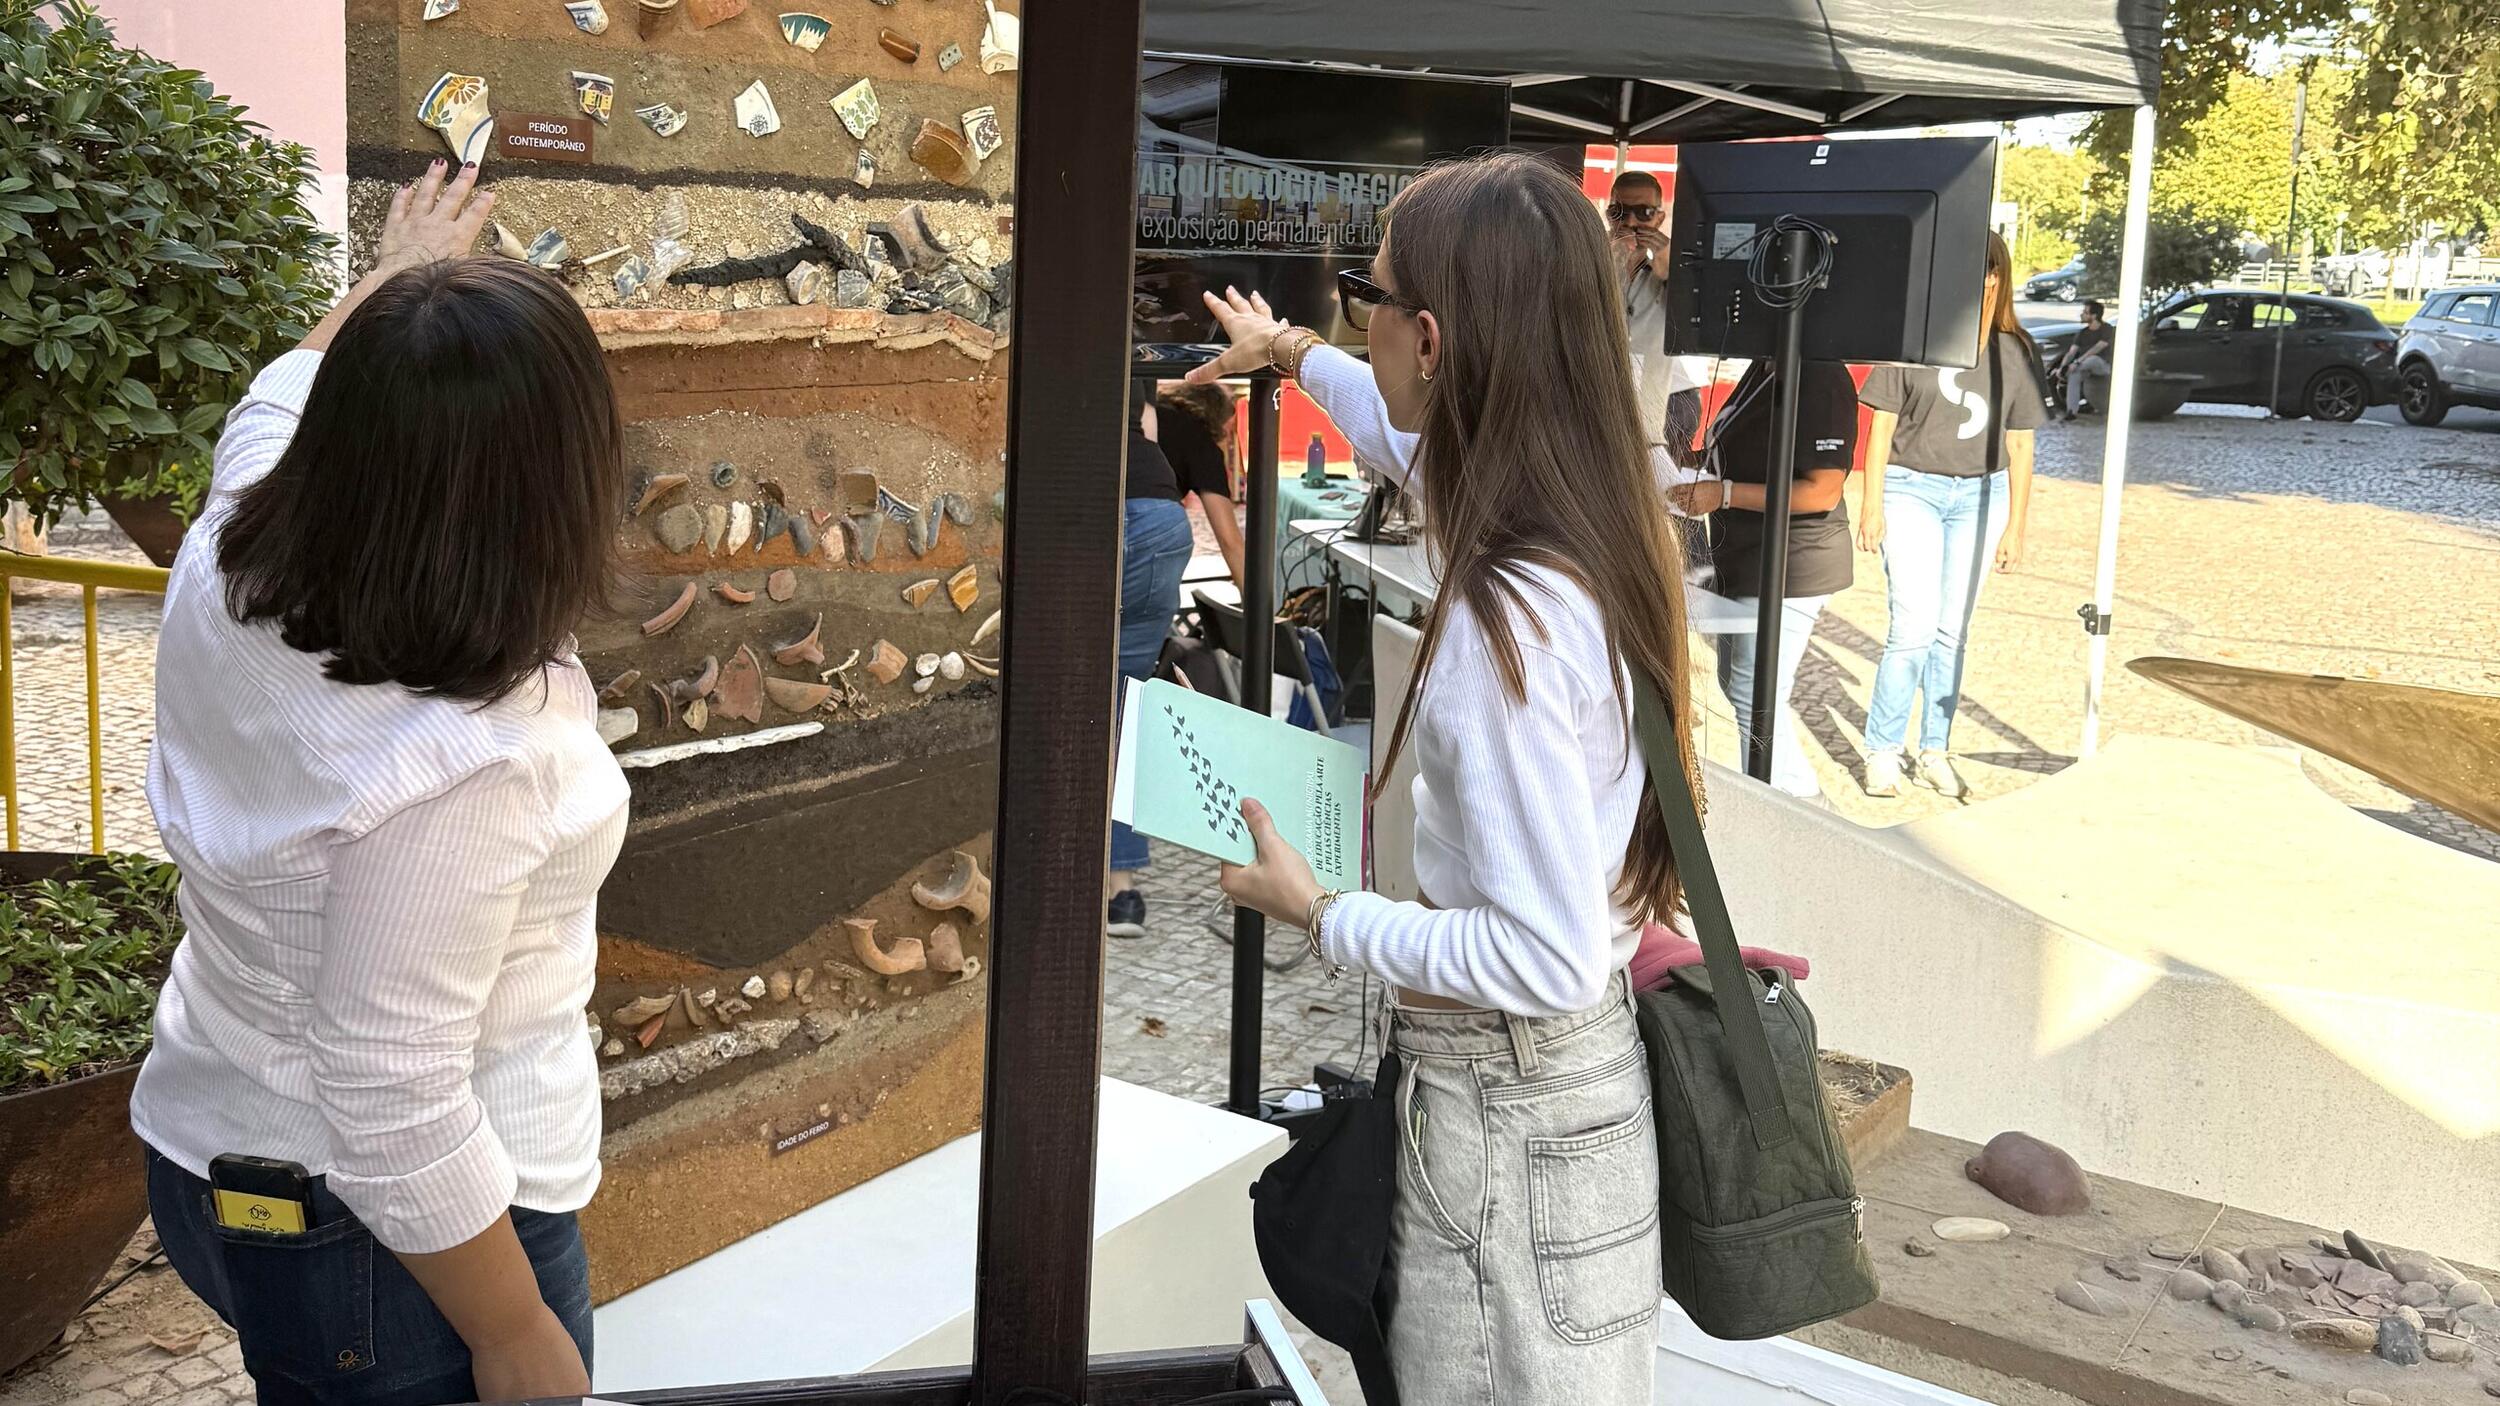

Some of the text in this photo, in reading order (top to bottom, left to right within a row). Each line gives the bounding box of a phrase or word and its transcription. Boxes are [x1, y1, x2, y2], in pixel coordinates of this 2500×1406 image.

[508, 135, 586, 152] CONTEMPORÂNEO
[528, 121, 568, 135] PERÍODO
[1139, 162, 1328, 206] ARQUEOLOGIA
[1141, 211, 1382, 248] exposição permanente do
[1305, 771, 1315, 813] MUNICIPAL
[1313, 756, 1324, 870] DE EDUCAÇÃO PELA ARTE
[1323, 791, 1332, 837] CIÊNCIAS
[1333, 801, 1343, 877] EXPERIMENTAIS
[777, 1121, 829, 1150] IDADE DO FERRO
